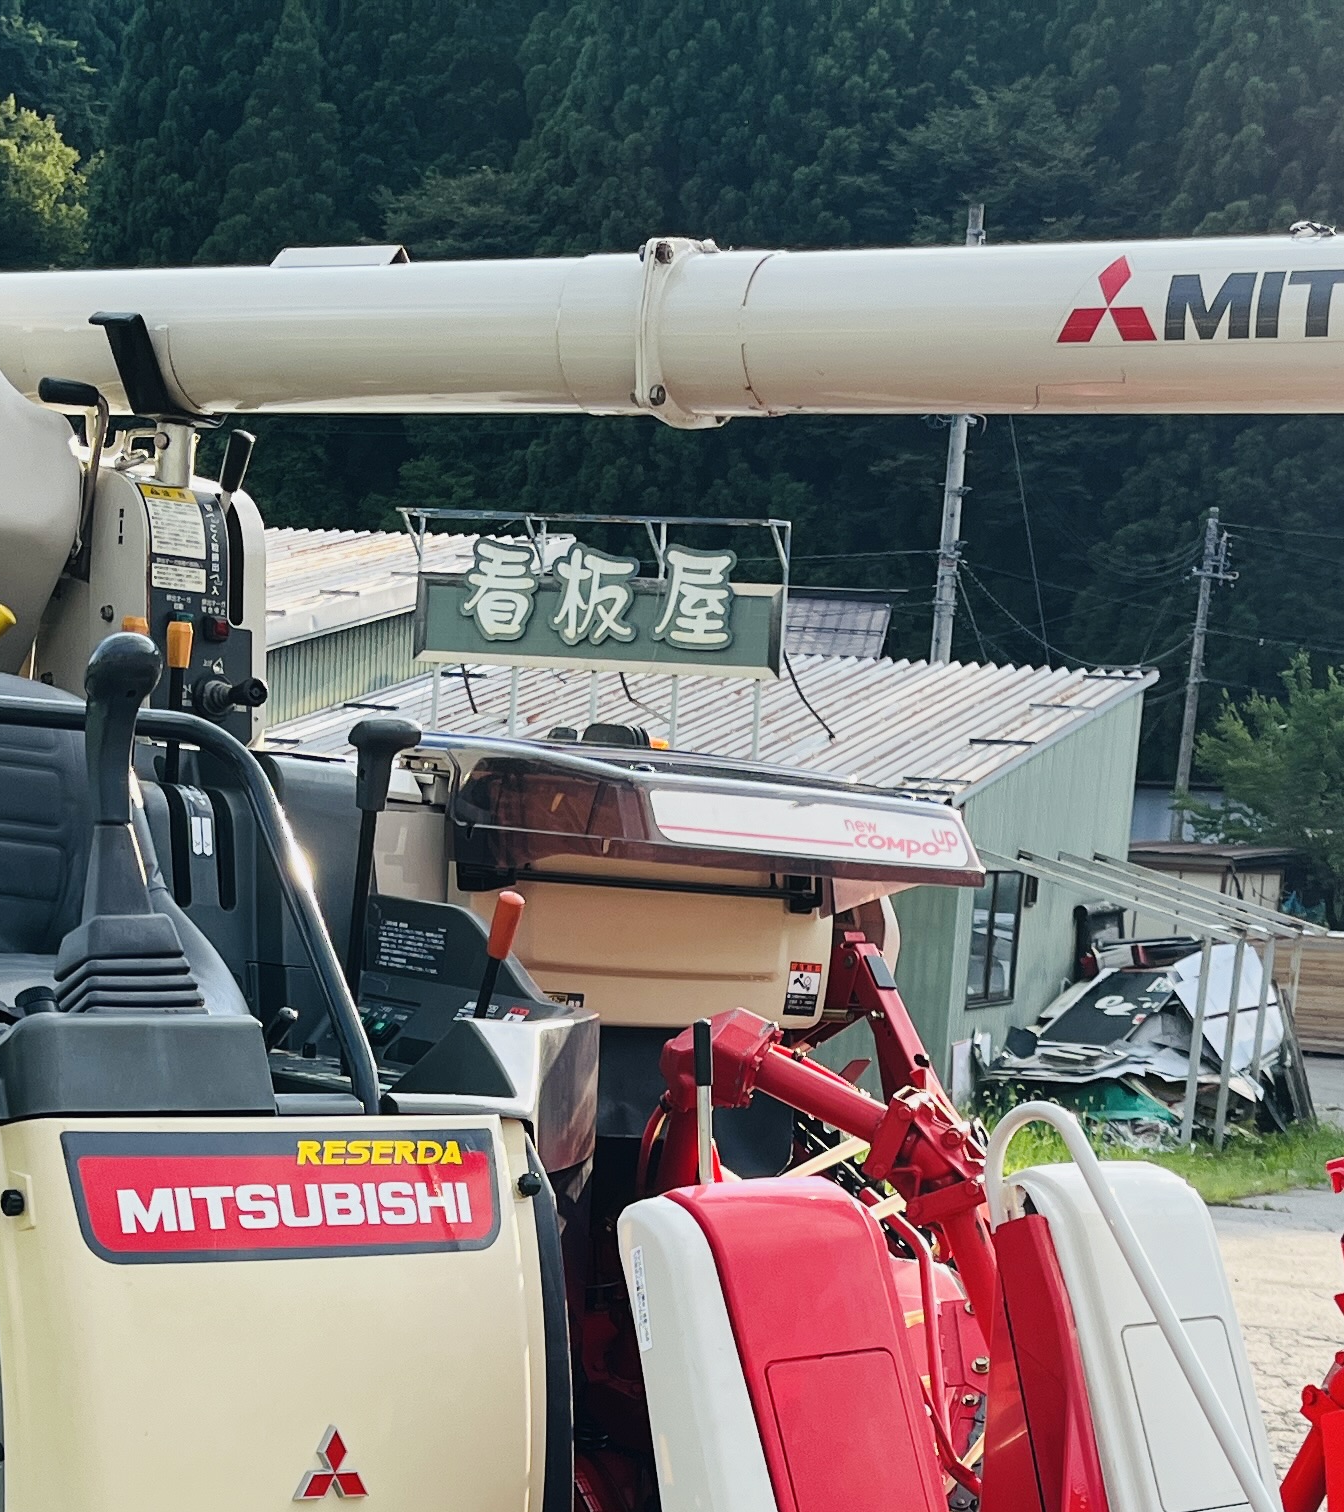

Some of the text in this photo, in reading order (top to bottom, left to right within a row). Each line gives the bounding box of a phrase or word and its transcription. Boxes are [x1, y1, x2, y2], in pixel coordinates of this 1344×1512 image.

[464, 539, 733, 645] 看板屋
[844, 819, 876, 833] new
[296, 1140, 463, 1166] RESERDA
[116, 1181, 472, 1234] MITSUBISHI
